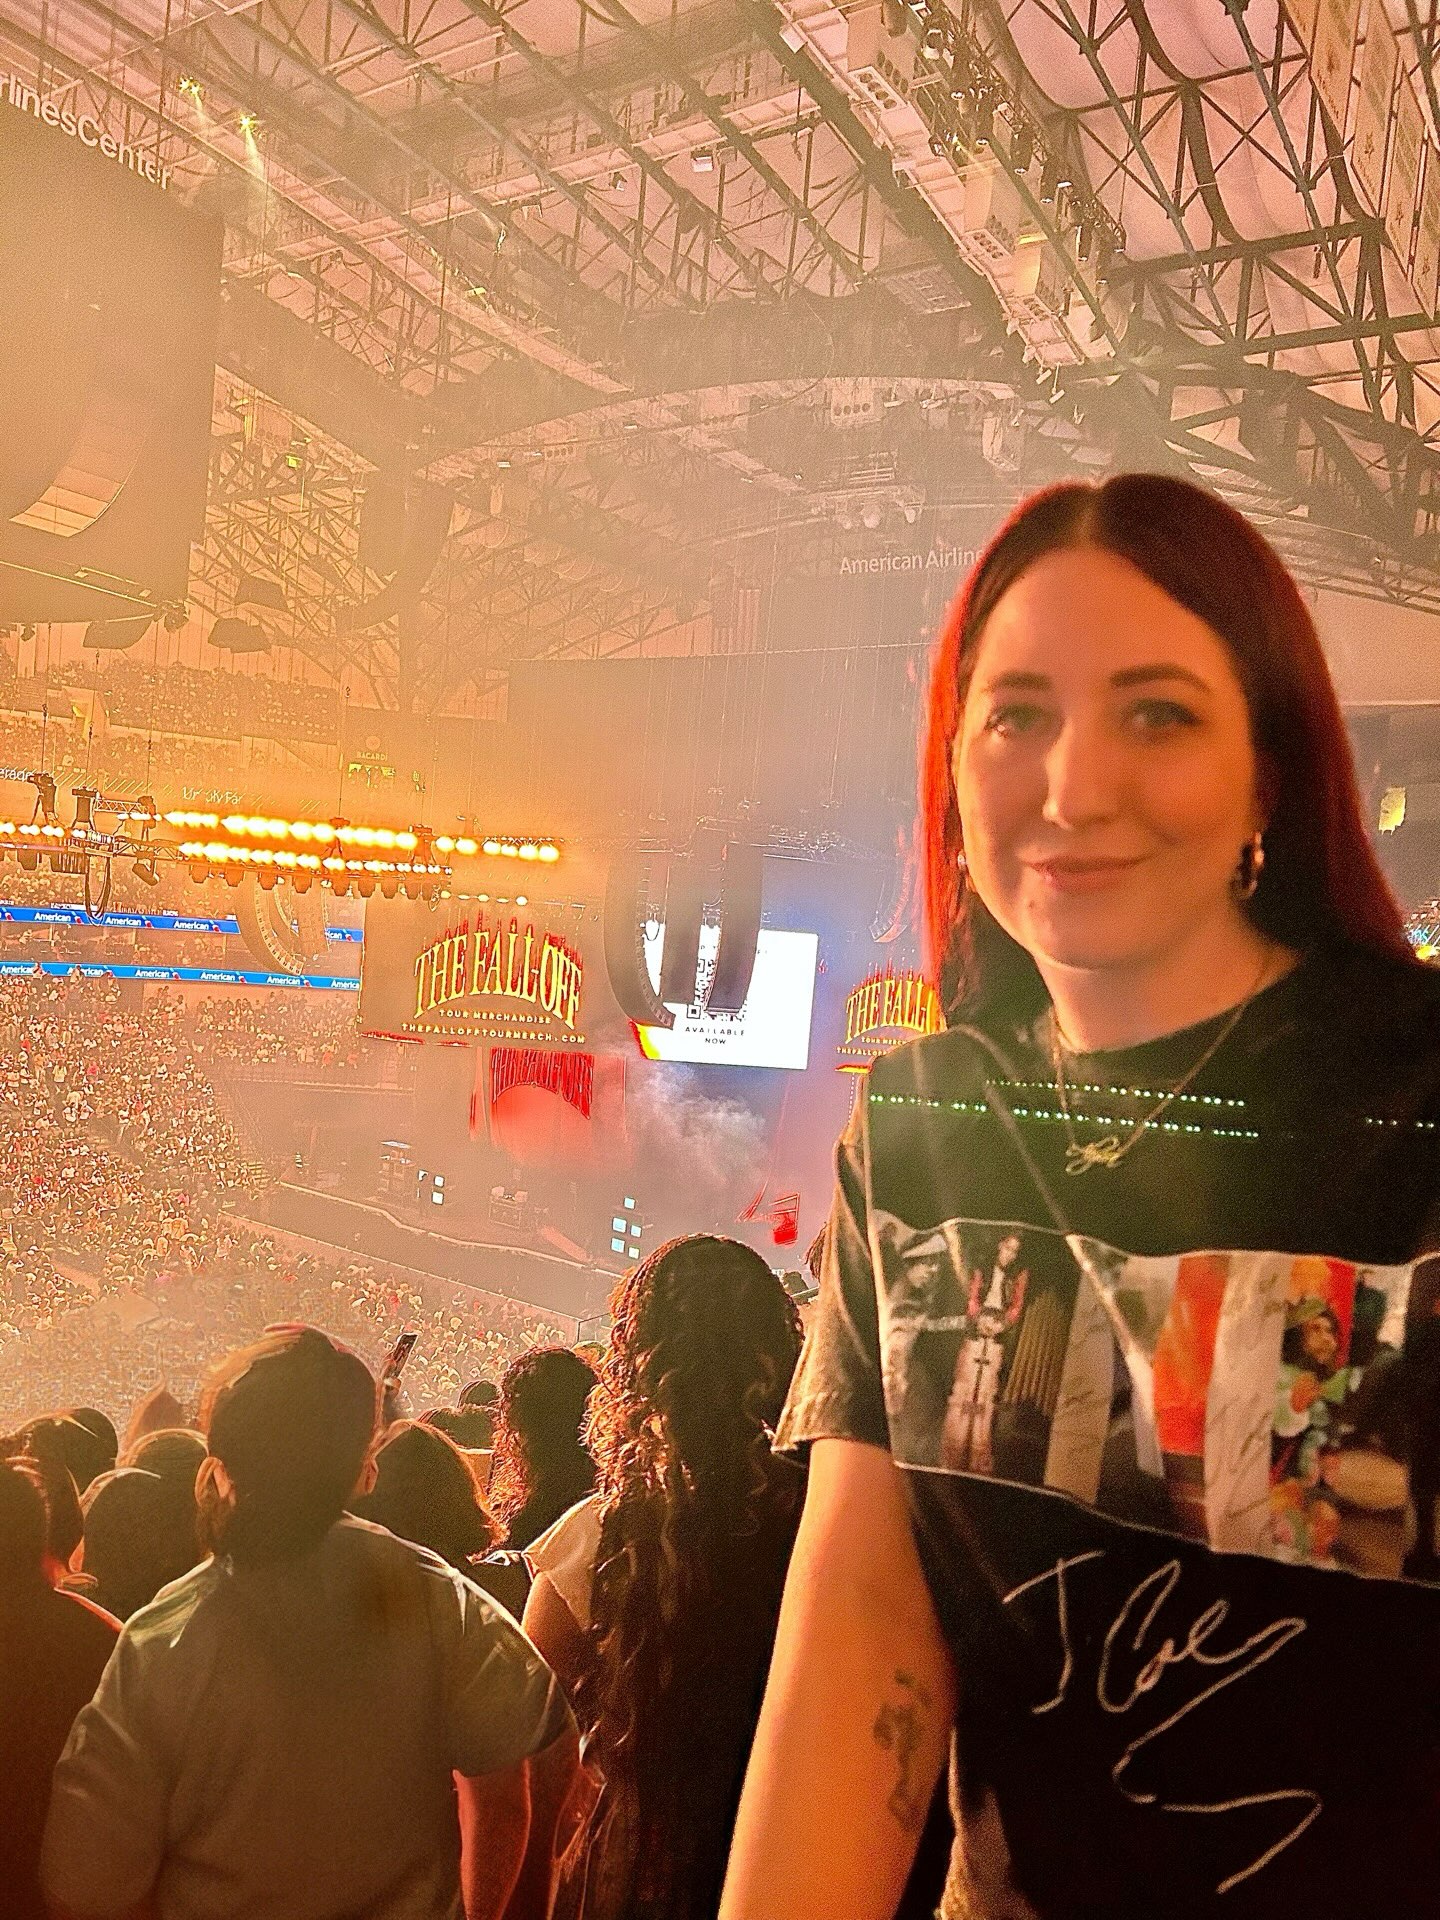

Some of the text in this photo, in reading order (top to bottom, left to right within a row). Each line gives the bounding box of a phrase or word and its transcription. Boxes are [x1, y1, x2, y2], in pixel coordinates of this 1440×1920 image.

[840, 552, 923, 575] American
[34, 912, 71, 922] American
[105, 916, 142, 926] American
[173, 920, 209, 931] American
[135, 969, 170, 979] American
[200, 972, 236, 982] American
[413, 928, 583, 1030] THE FALL-OFF
[266, 976, 300, 986] American
[330, 979, 360, 990] America
[439, 1008, 552, 1025] TOUR MERCHANDISE
[845, 981, 881, 1044] THE
[401, 1022, 586, 1044] THEFALLOFFTOURMERCH.COM
[684, 1025, 745, 1037] AVAILABLE
[704, 1037, 727, 1046] NOW
[861, 1036, 881, 1044] TOUR
[1003, 1550, 1105, 1715] J
